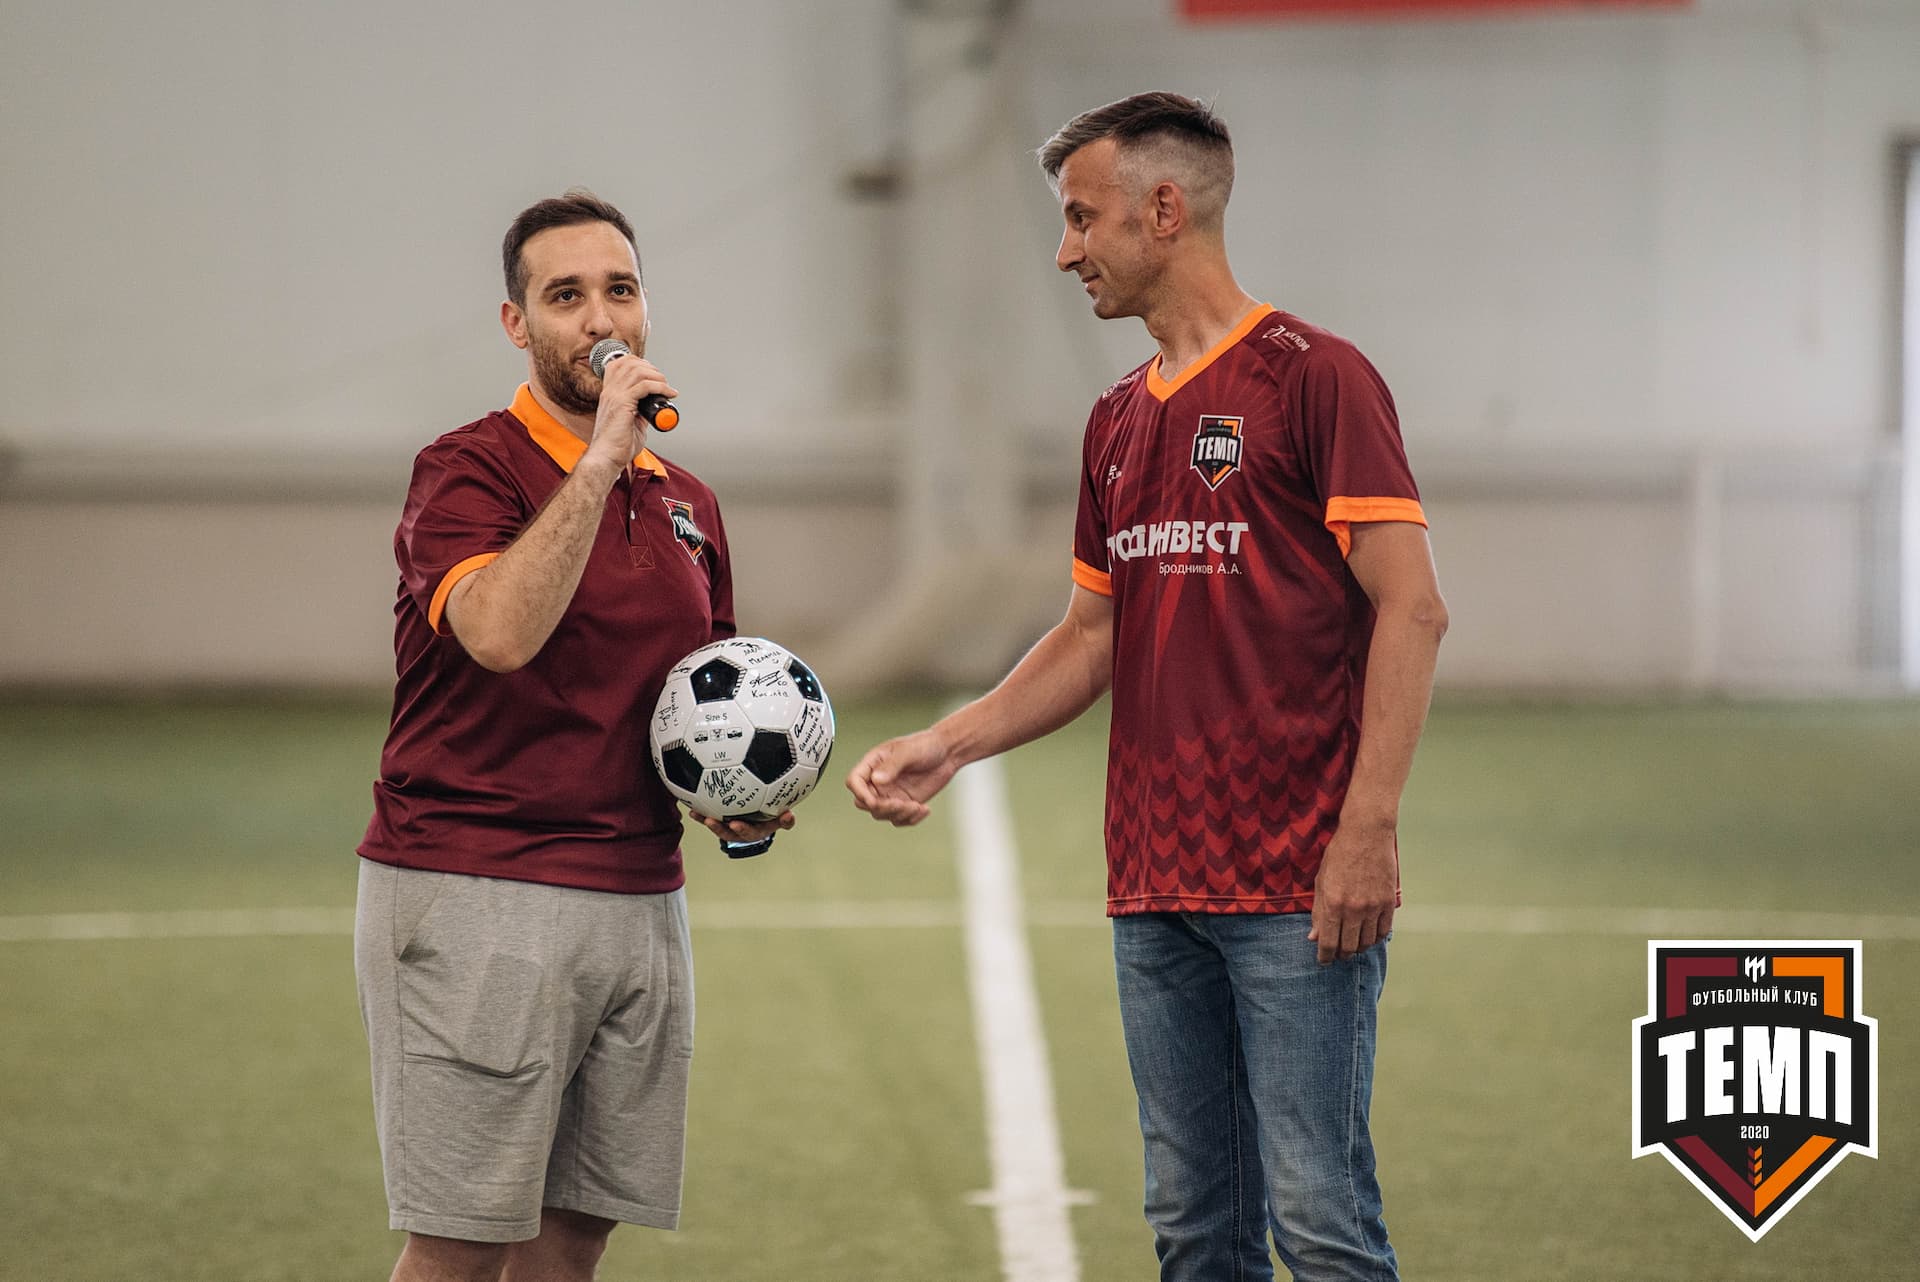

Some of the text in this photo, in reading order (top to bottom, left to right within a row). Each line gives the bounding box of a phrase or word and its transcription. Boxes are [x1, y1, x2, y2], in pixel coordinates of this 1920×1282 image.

[1197, 436, 1238, 463] ТЕМП
[1159, 561, 1242, 576] Бродников А.А.
[722, 712, 728, 721] 5
[714, 751, 727, 760] LW
